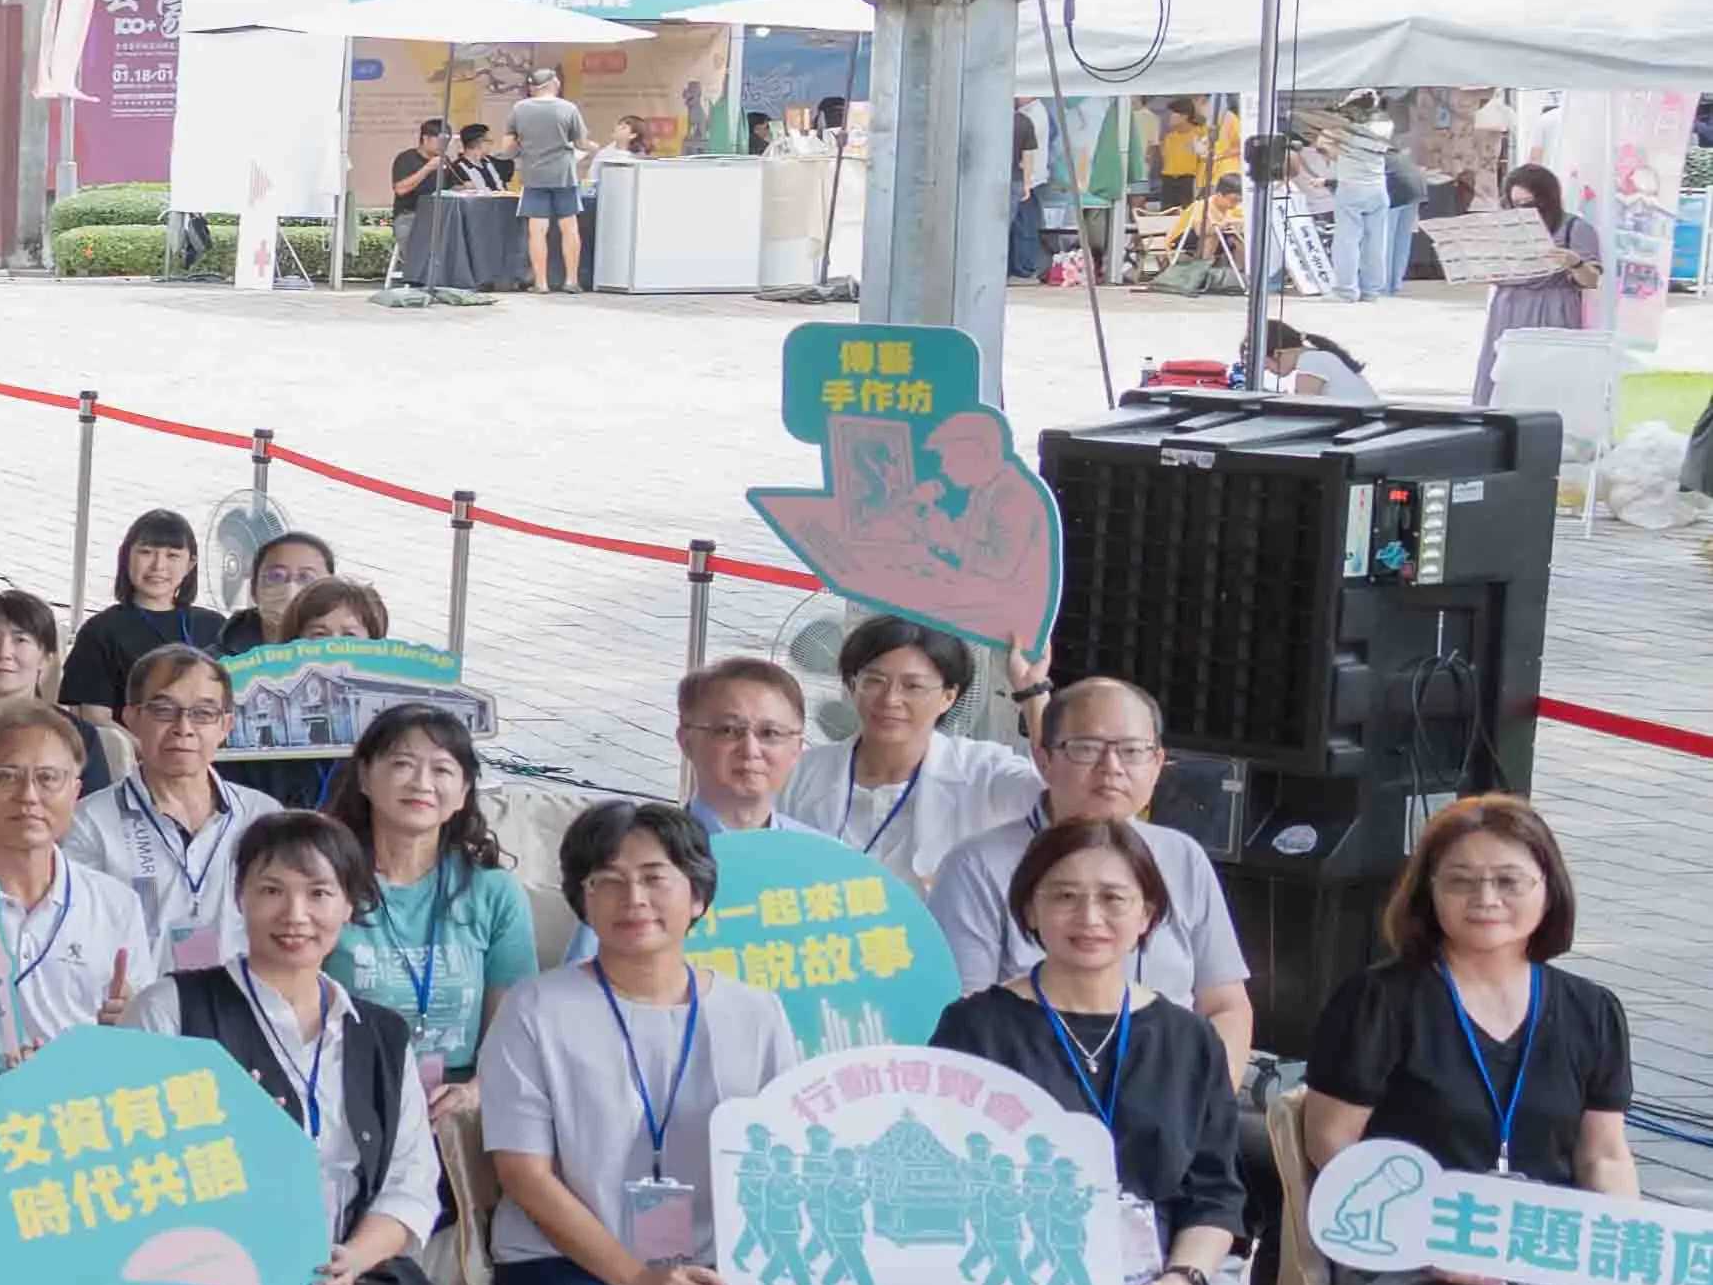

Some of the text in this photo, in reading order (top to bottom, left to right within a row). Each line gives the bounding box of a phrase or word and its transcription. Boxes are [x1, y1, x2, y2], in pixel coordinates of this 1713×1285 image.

[821, 378, 933, 413] 手作坊
[266, 647, 293, 663] Day
[297, 644, 322, 658] For
[325, 641, 388, 657] Cultural
[391, 644, 455, 667] Heritage
[791, 1059, 1034, 1133] 行動博覽會
[11, 1135, 249, 1242] 時代共語
